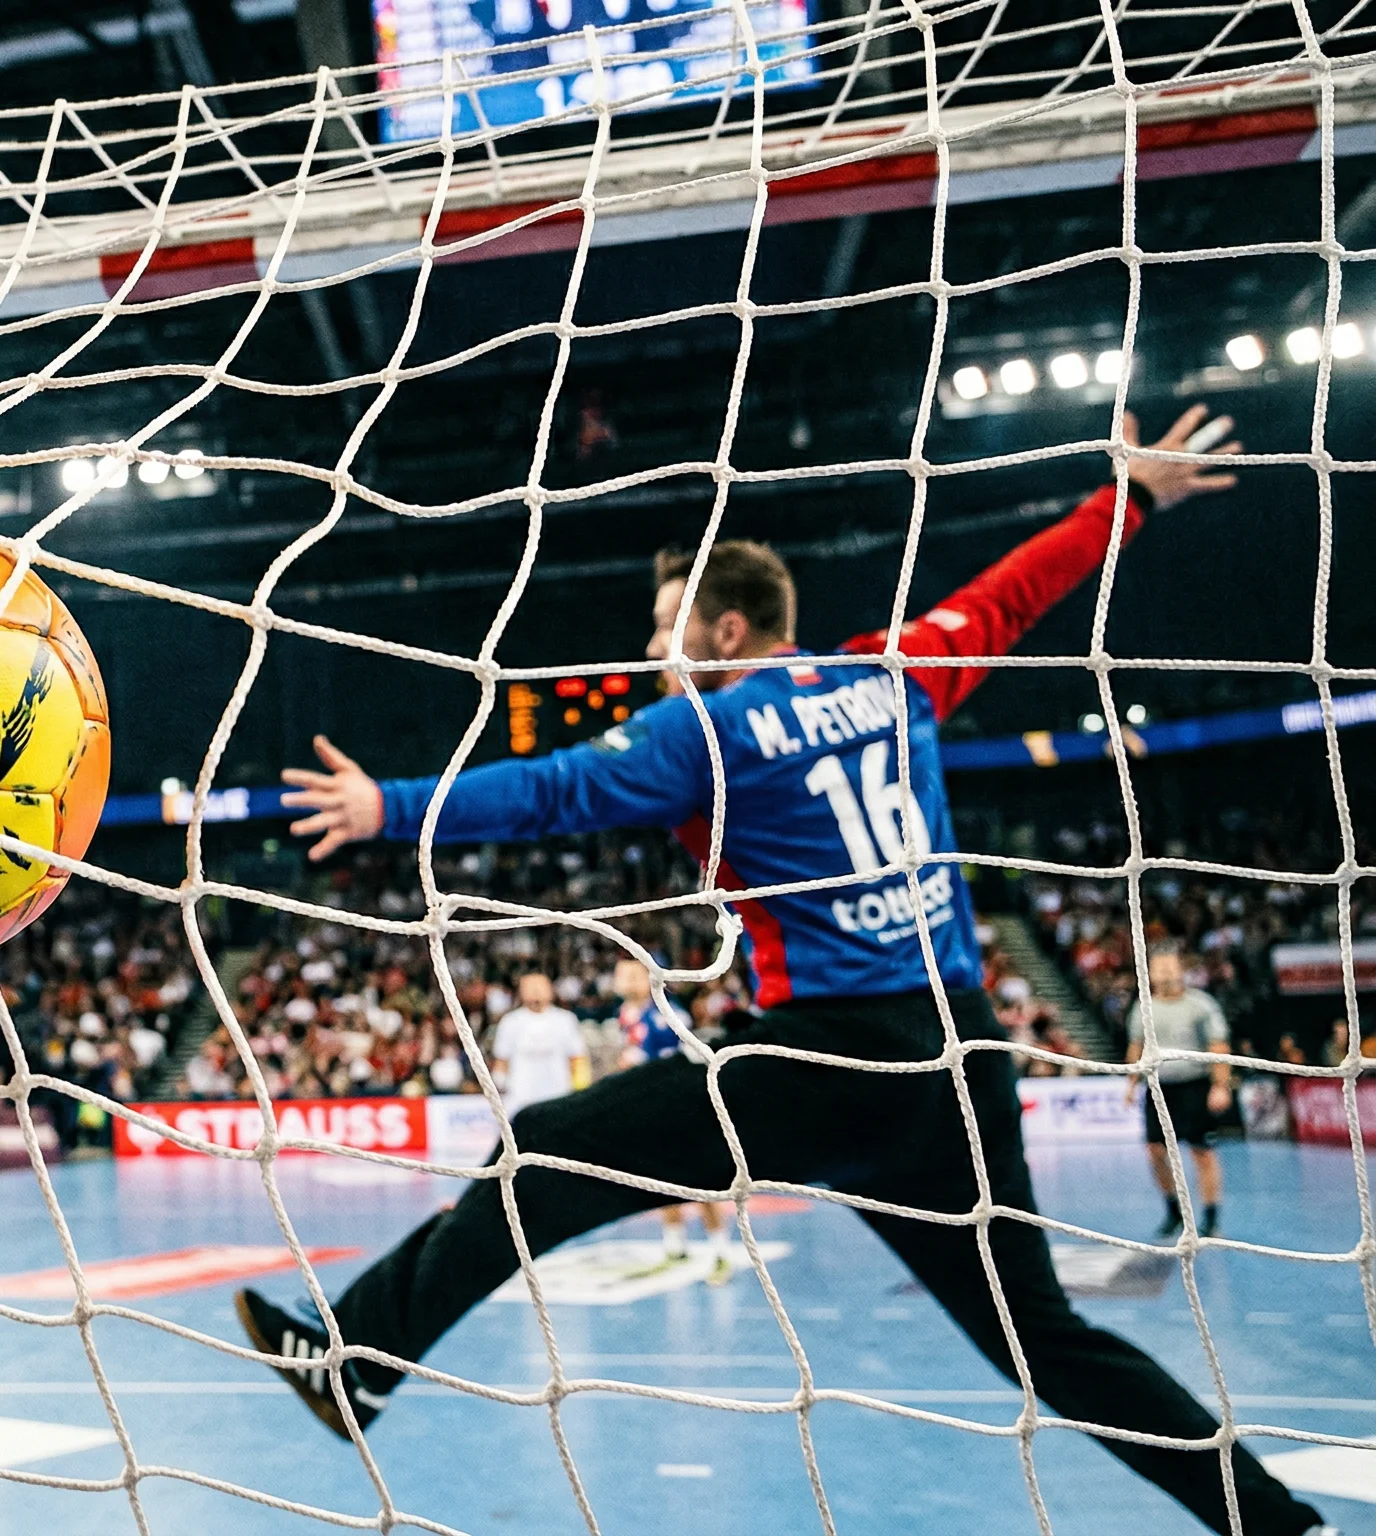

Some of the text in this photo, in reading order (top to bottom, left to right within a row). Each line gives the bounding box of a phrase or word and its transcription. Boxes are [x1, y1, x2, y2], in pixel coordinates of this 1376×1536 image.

[745, 703, 802, 760] M.
[804, 740, 931, 884] 16
[176, 1104, 411, 1149] STRAUSS
